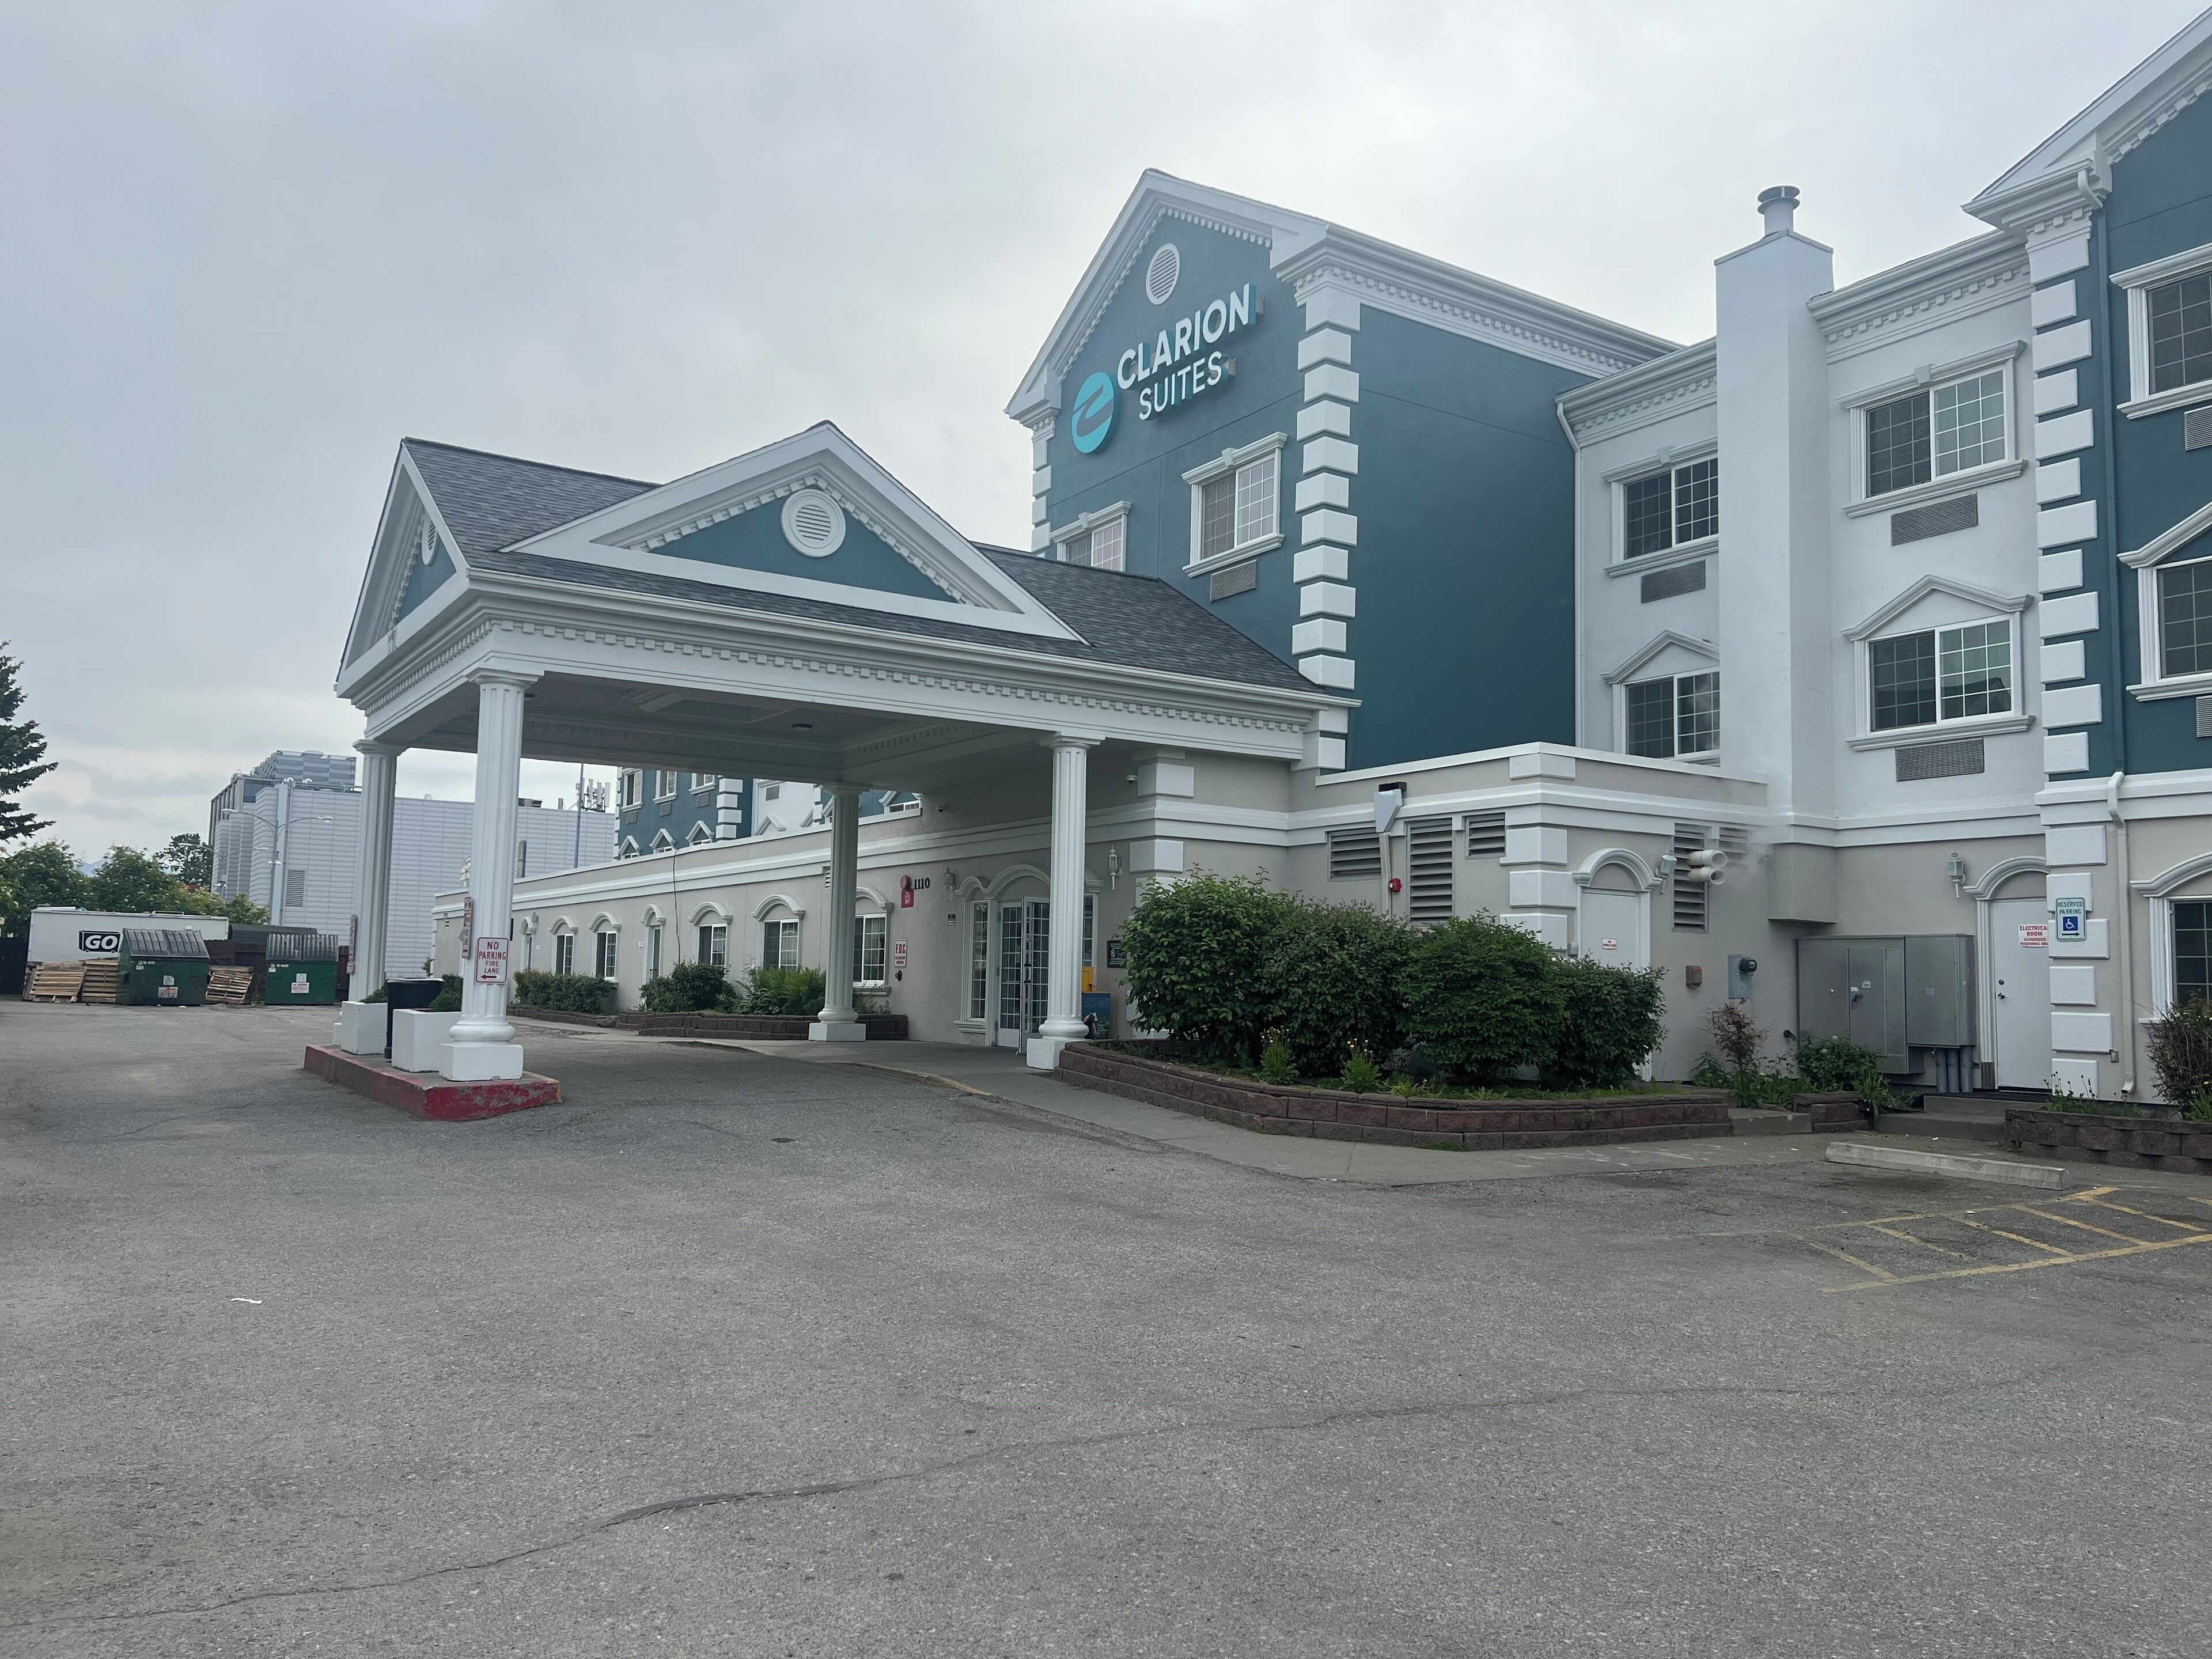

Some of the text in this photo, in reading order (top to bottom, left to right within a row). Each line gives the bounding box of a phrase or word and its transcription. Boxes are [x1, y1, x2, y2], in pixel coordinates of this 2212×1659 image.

[1117, 282, 1253, 390] CLARION
[1138, 350, 1225, 421] SUITES
[914, 877, 930, 890] 1110
[85, 934, 118, 949] GO
[487, 941, 499, 950] NO
[478, 950, 506, 960] PARKING
